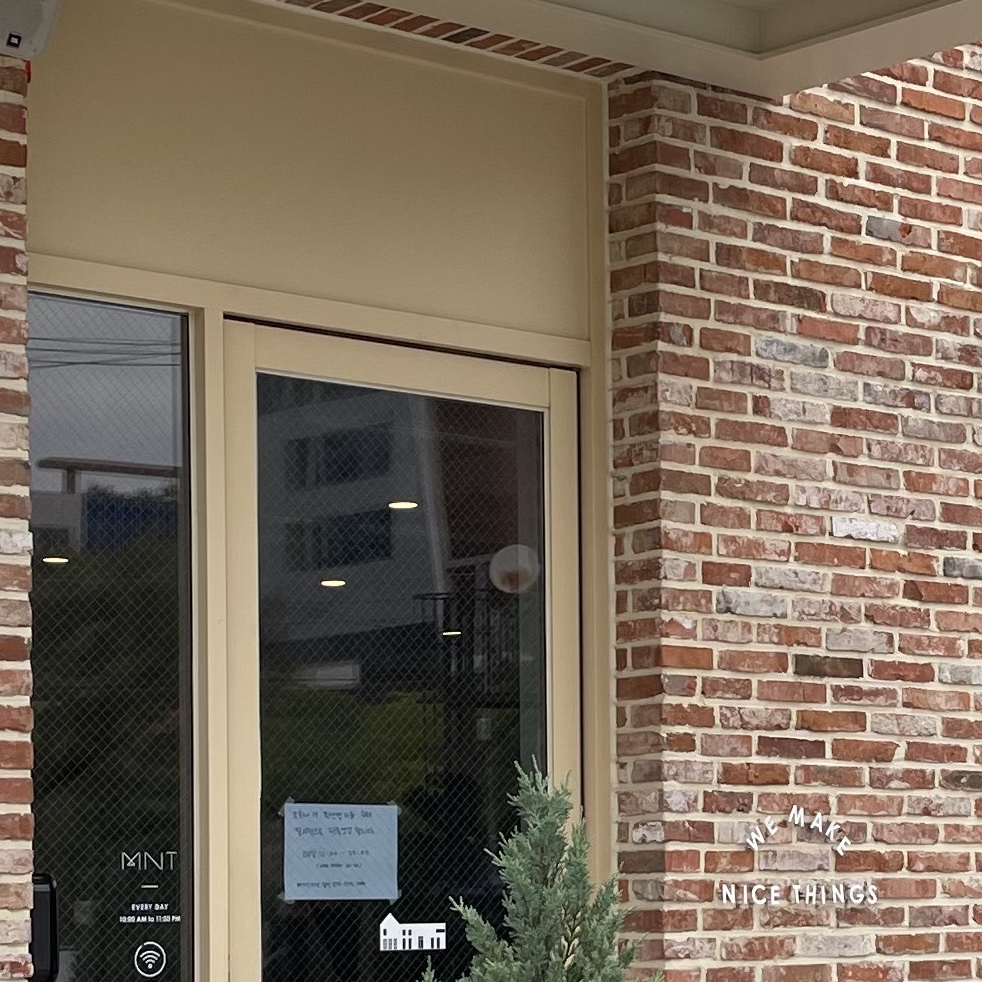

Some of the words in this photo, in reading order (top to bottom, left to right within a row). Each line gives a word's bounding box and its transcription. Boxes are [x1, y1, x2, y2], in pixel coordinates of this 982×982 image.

[745, 815, 779, 851] WE
[788, 804, 852, 857] MAKE
[722, 883, 781, 905] NICE
[792, 882, 878, 905] THINGS
[131, 903, 153, 911] EVERY
[154, 903, 169, 911] DAY
[136, 915, 147, 923] AM
[171, 915, 181, 923] PM
